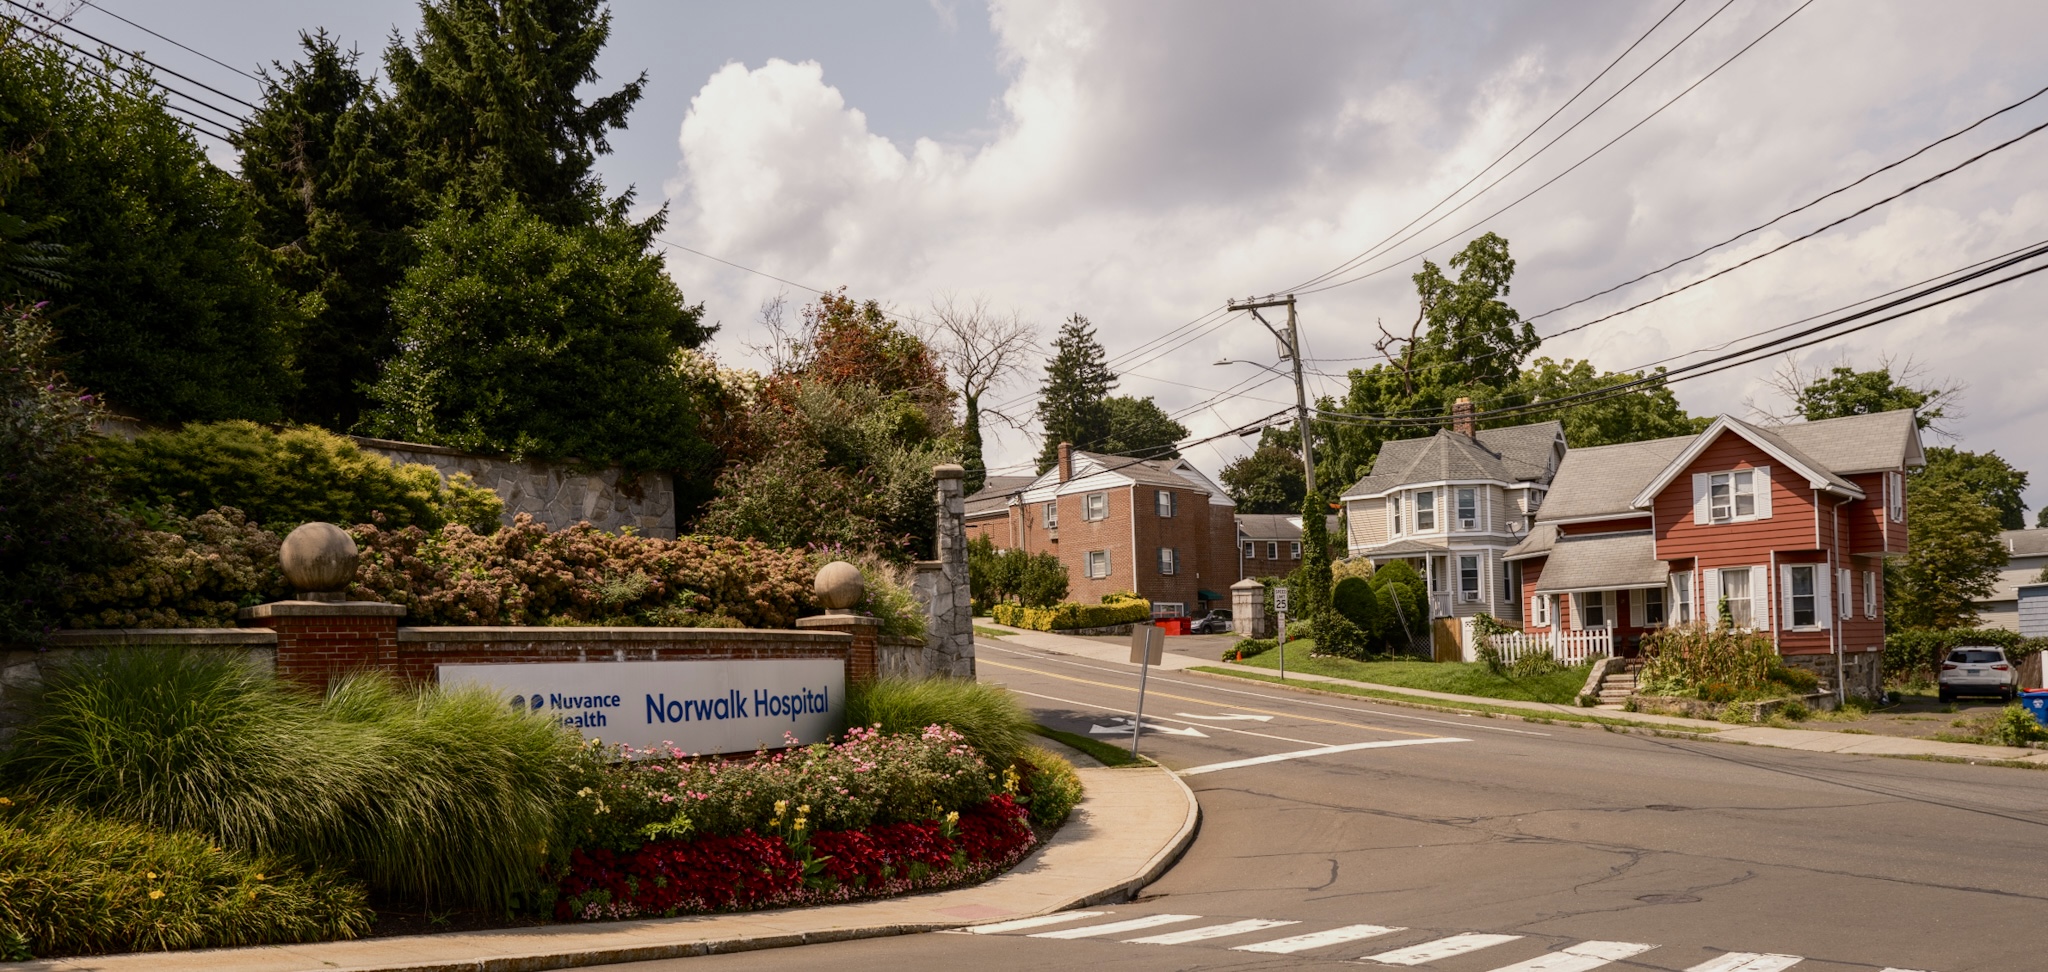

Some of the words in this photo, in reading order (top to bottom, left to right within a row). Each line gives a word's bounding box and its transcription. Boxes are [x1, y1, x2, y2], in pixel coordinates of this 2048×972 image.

[1276, 600, 1286, 608] 25
[550, 693, 621, 710] Nuvance
[646, 689, 748, 724] Norwalk
[754, 685, 829, 722] Hospital
